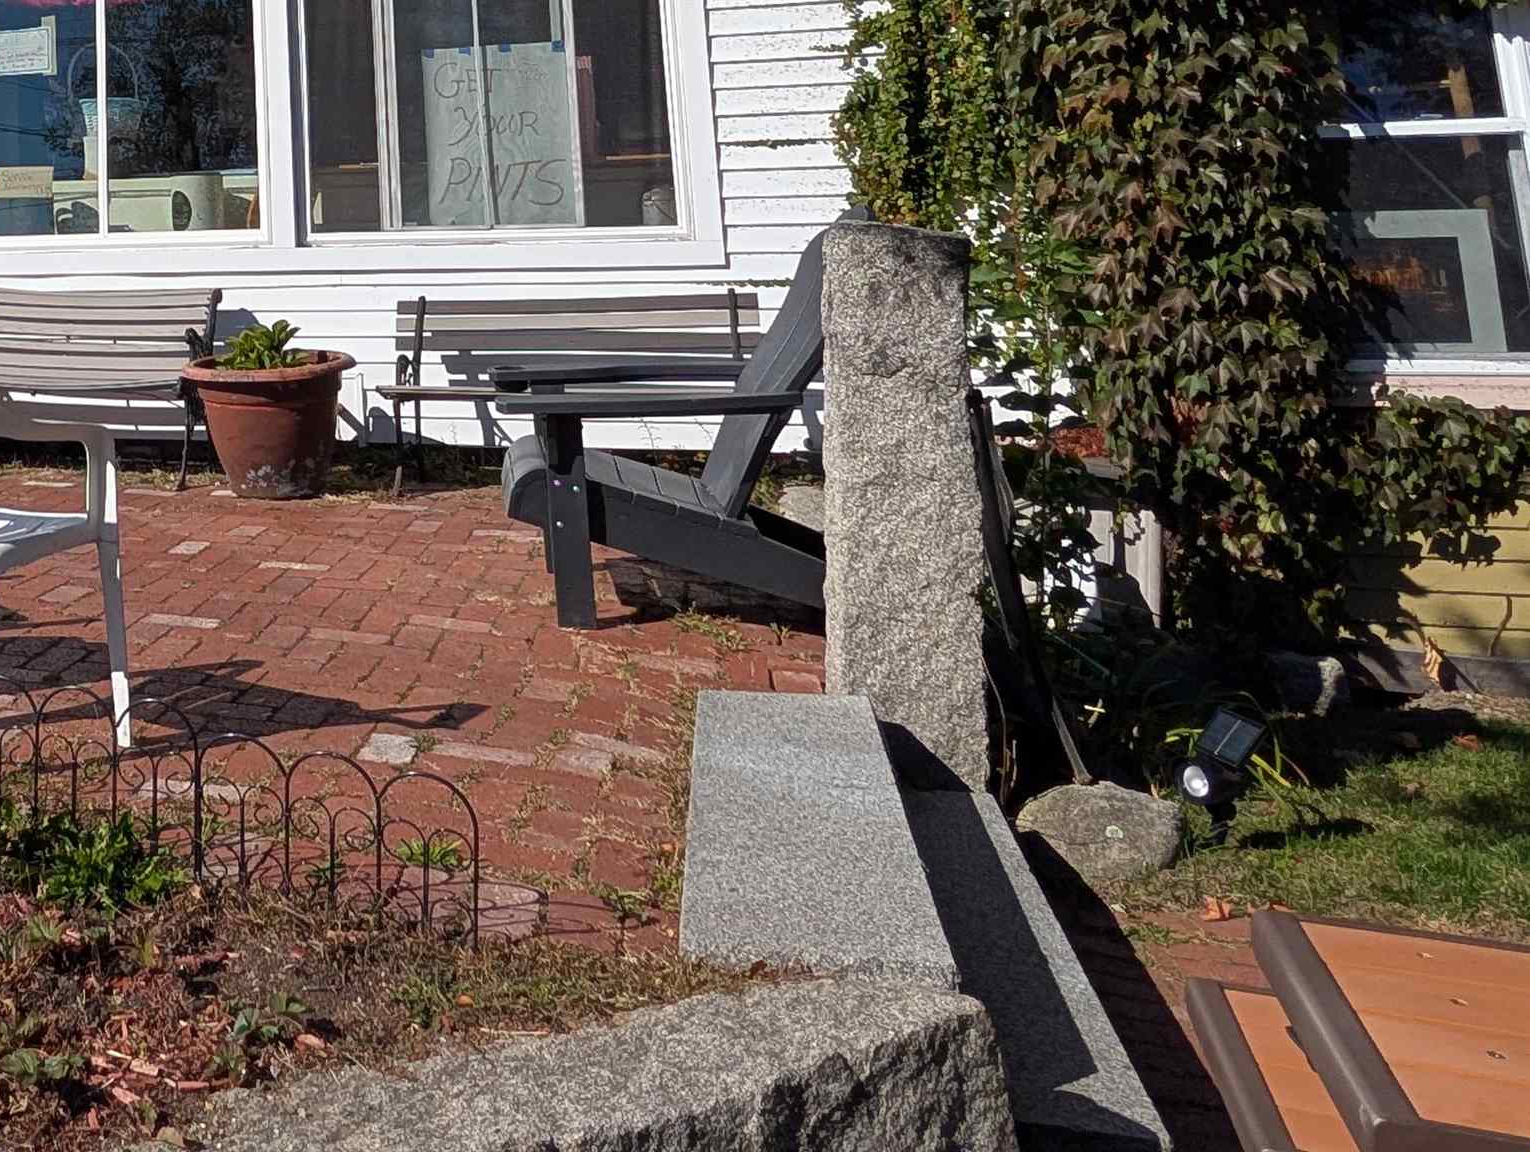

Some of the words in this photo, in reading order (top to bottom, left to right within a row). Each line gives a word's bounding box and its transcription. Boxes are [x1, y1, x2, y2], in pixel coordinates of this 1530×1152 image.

[434, 62, 503, 98] GET
[449, 106, 540, 146] YOUR
[438, 157, 567, 207] PINTS
